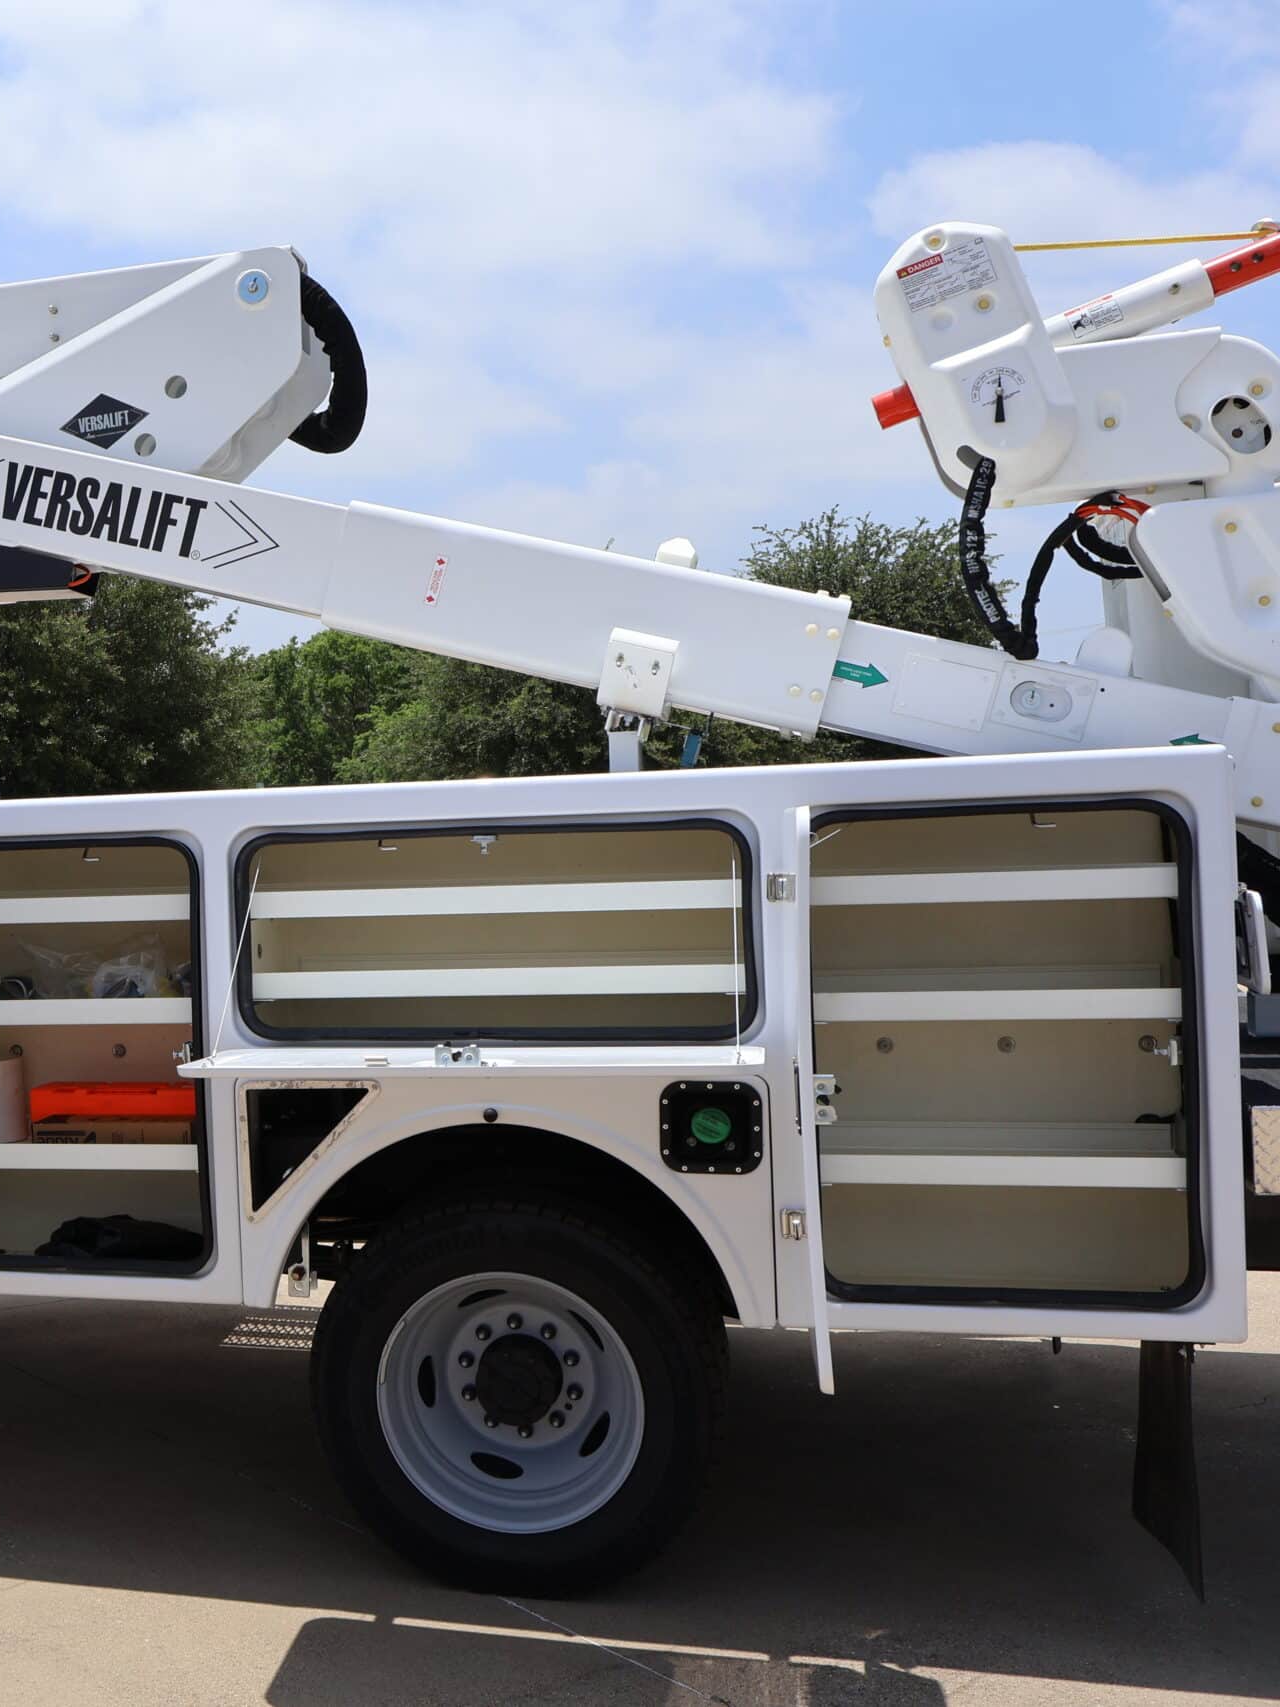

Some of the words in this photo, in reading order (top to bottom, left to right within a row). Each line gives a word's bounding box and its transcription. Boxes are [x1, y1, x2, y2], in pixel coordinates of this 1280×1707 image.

[907, 256, 941, 273] DANGER
[78, 410, 129, 433] VERSALIFT
[2, 461, 208, 558] VERSALIFT
